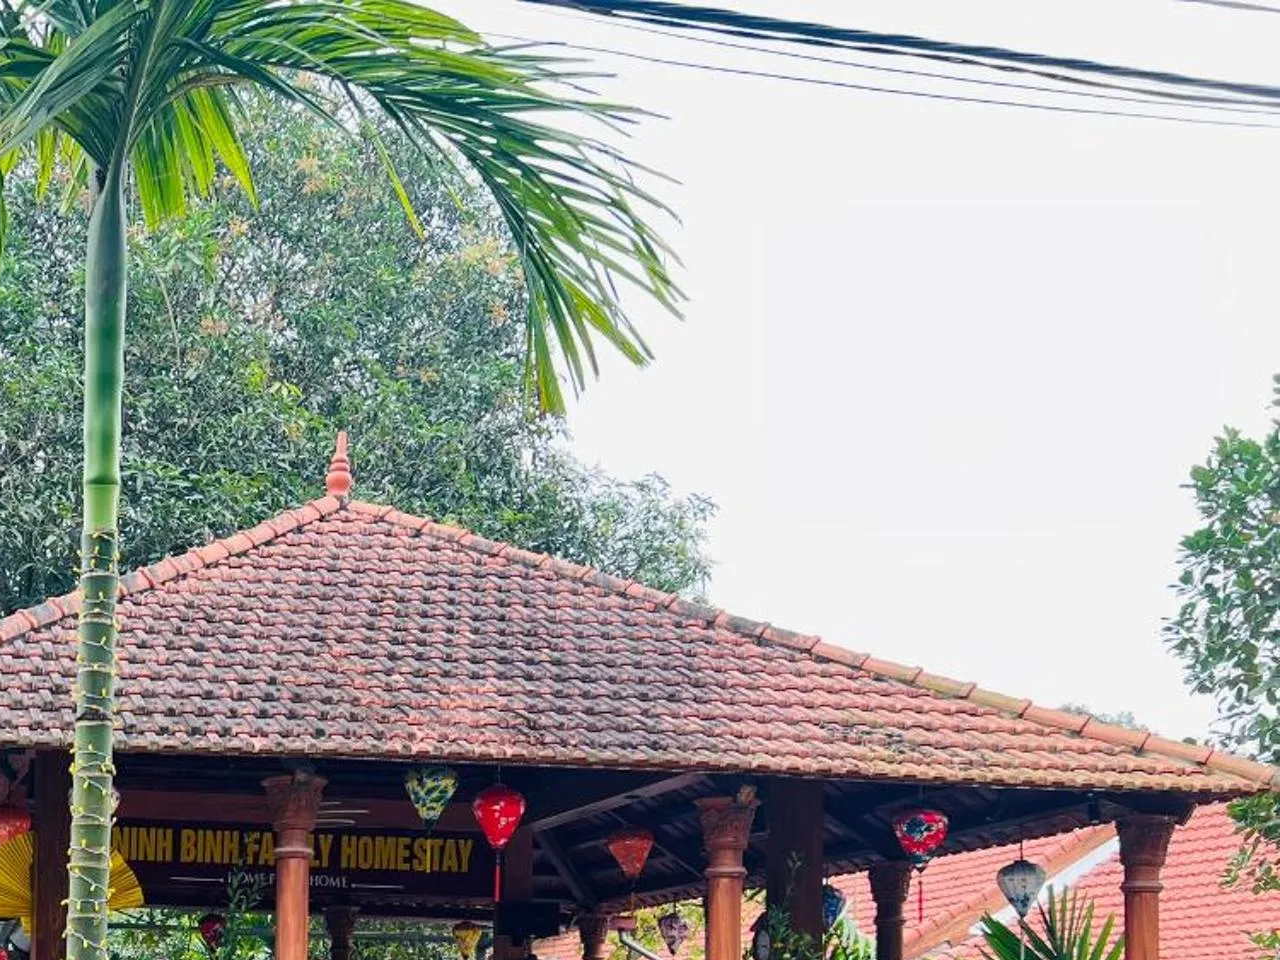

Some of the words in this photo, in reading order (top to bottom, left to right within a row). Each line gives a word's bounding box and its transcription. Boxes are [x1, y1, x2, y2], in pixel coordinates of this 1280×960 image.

[111, 825, 173, 862] NINH
[180, 828, 240, 864] BINH
[246, 831, 333, 868] FALY
[341, 834, 474, 872] HOMESTAY
[309, 875, 348, 888] HOME
